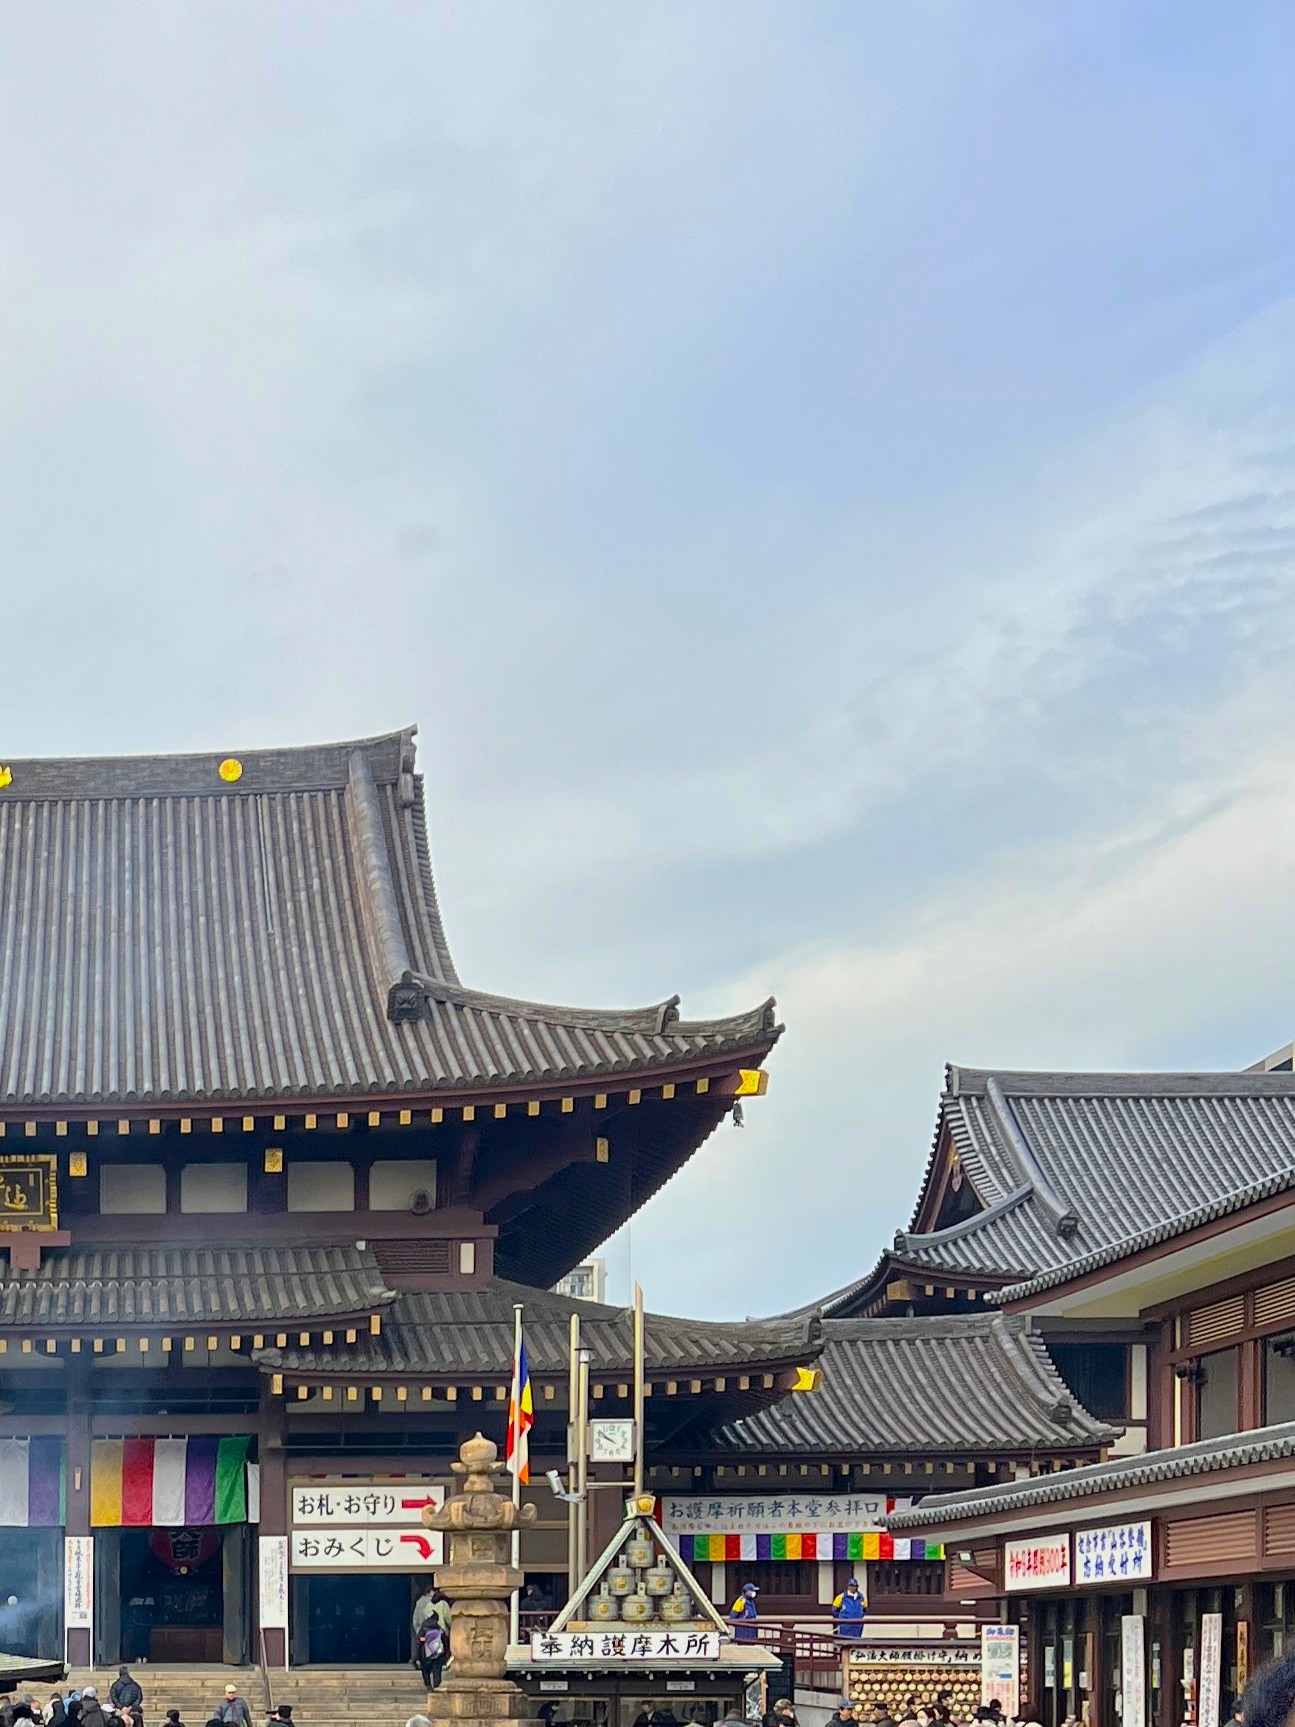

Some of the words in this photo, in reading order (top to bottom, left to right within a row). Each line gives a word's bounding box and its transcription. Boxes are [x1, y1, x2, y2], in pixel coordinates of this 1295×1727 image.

[298, 1493, 395, 1516] お札・お守り
[298, 1537, 394, 1558] おみくじ
[540, 1634, 710, 1657] 奉納護摩木所
